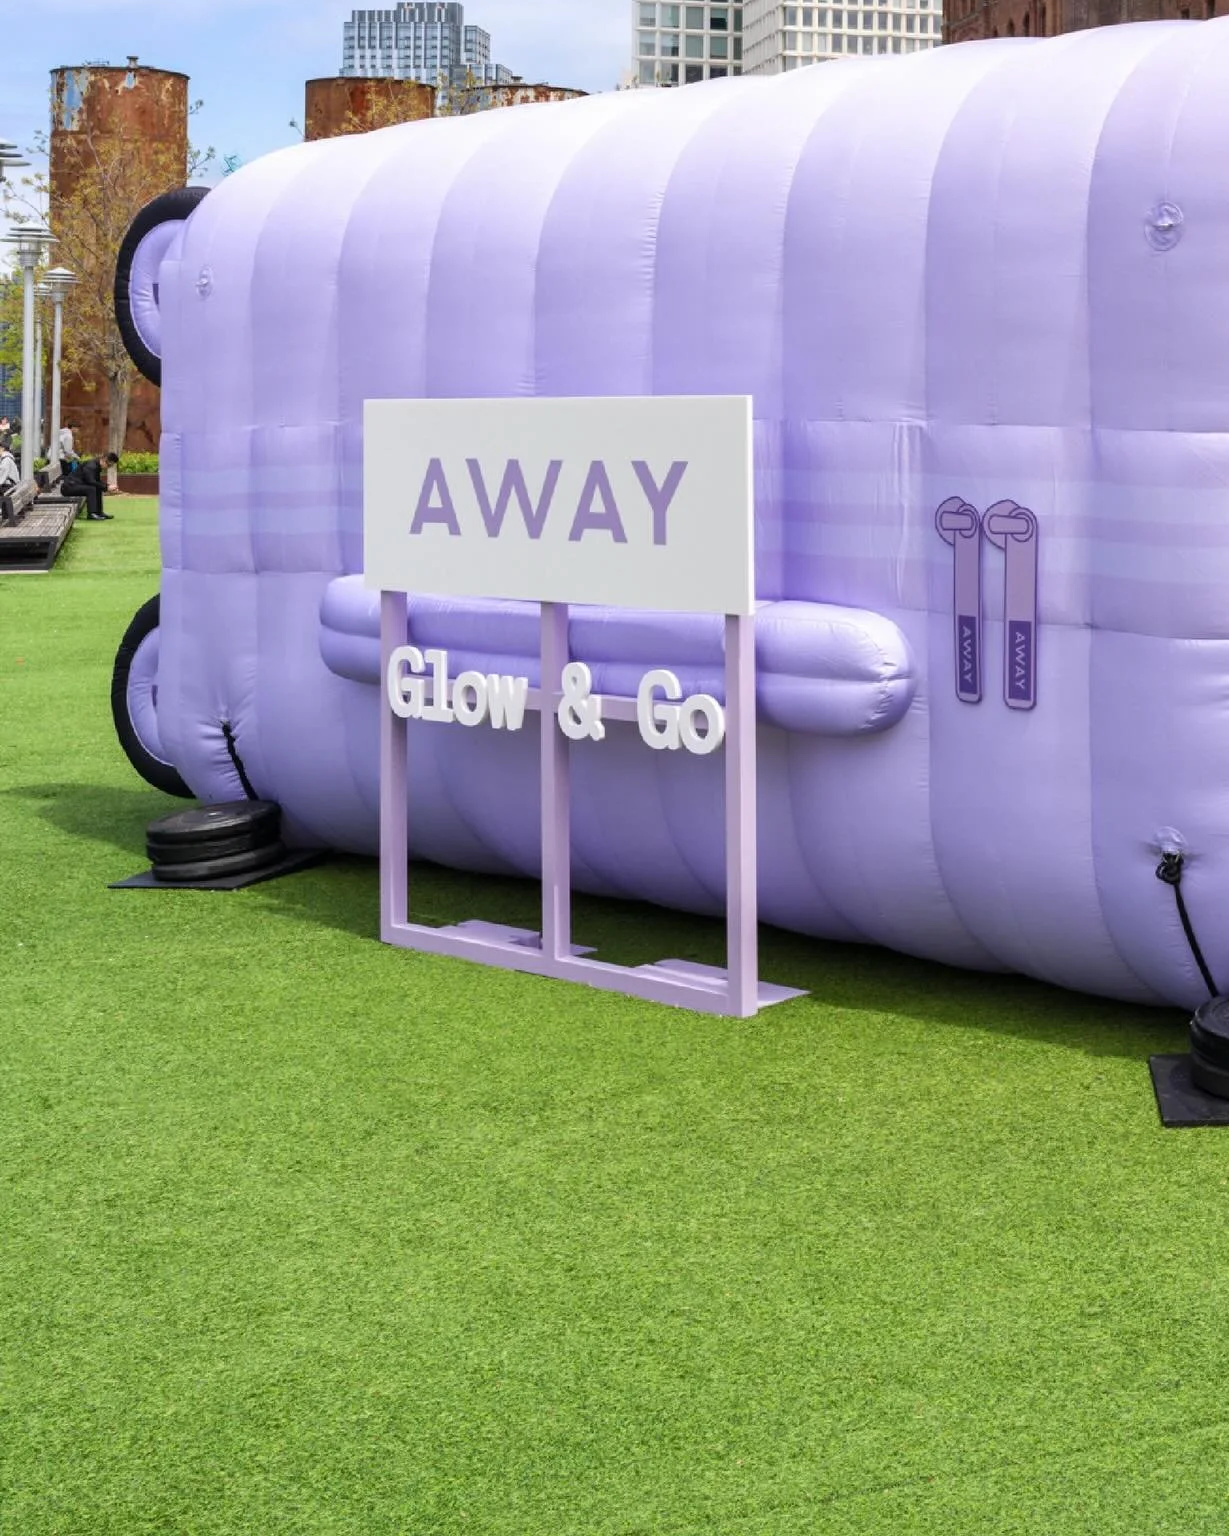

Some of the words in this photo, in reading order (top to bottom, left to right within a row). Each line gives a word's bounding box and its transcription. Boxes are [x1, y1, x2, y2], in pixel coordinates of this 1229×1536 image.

[408, 458, 689, 546] AWAY
[962, 625, 972, 683] AWAY
[1015, 631, 1025, 690] AWAY
[387, 645, 530, 732] Glow
[558, 661, 606, 742] &
[637, 669, 726, 755] Go
